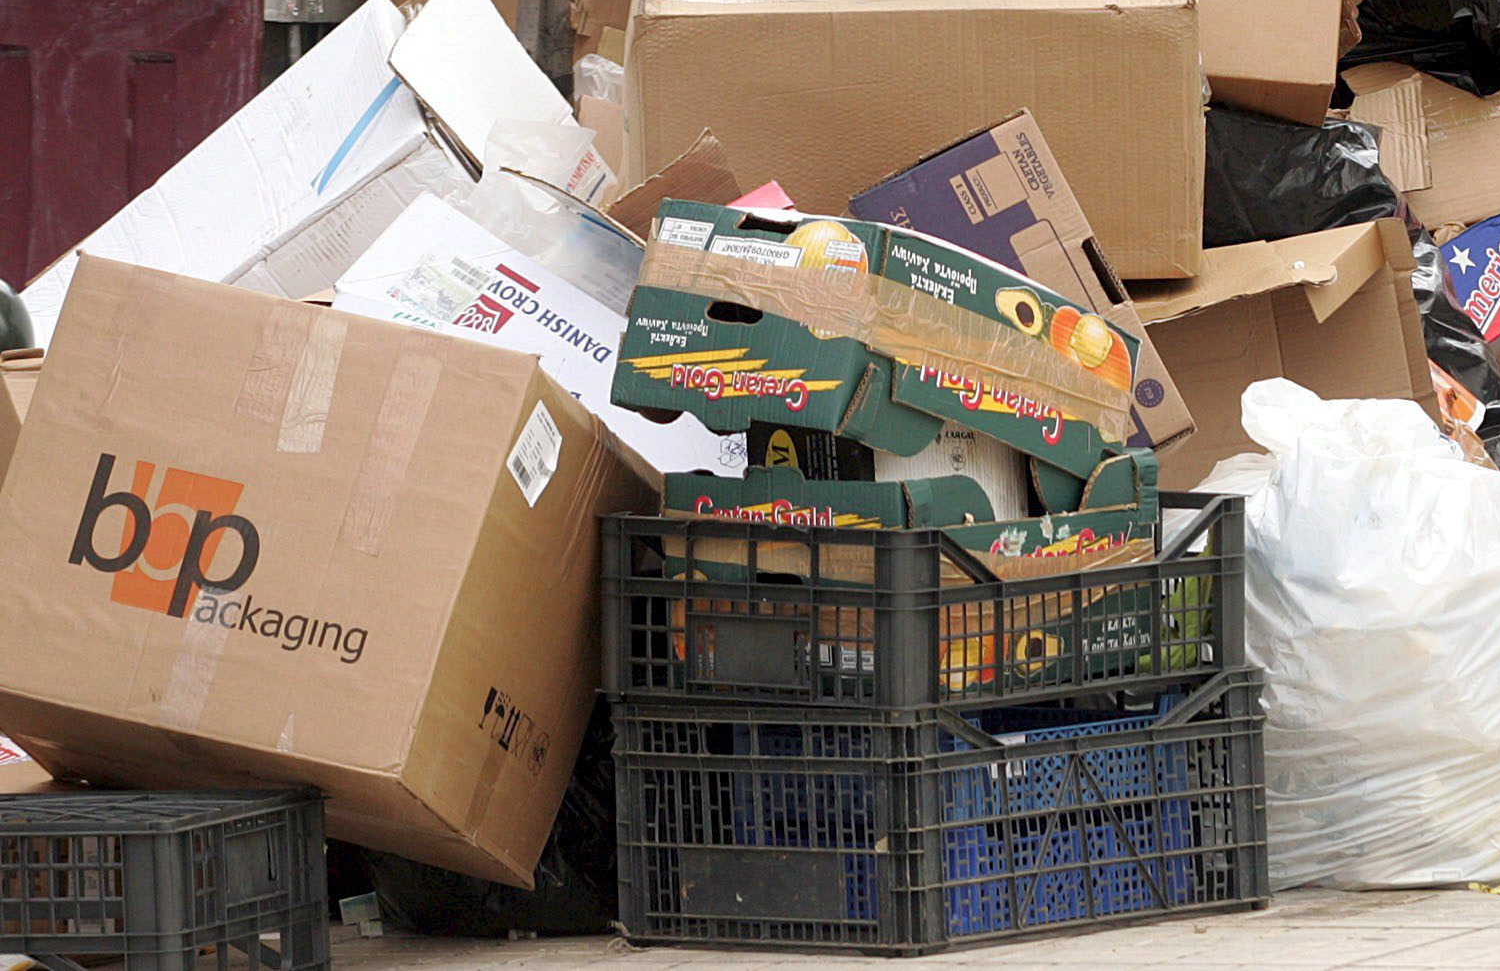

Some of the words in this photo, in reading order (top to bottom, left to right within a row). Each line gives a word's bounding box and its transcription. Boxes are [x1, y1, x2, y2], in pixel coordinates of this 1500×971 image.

[1012, 148, 1040, 191] CRETAN
[1016, 131, 1056, 199] VEGETABLES
[960, 190, 977, 216] CLASS
[536, 308, 613, 364] DANISH
[670, 363, 726, 401] Gold
[732, 370, 809, 412] Cretan
